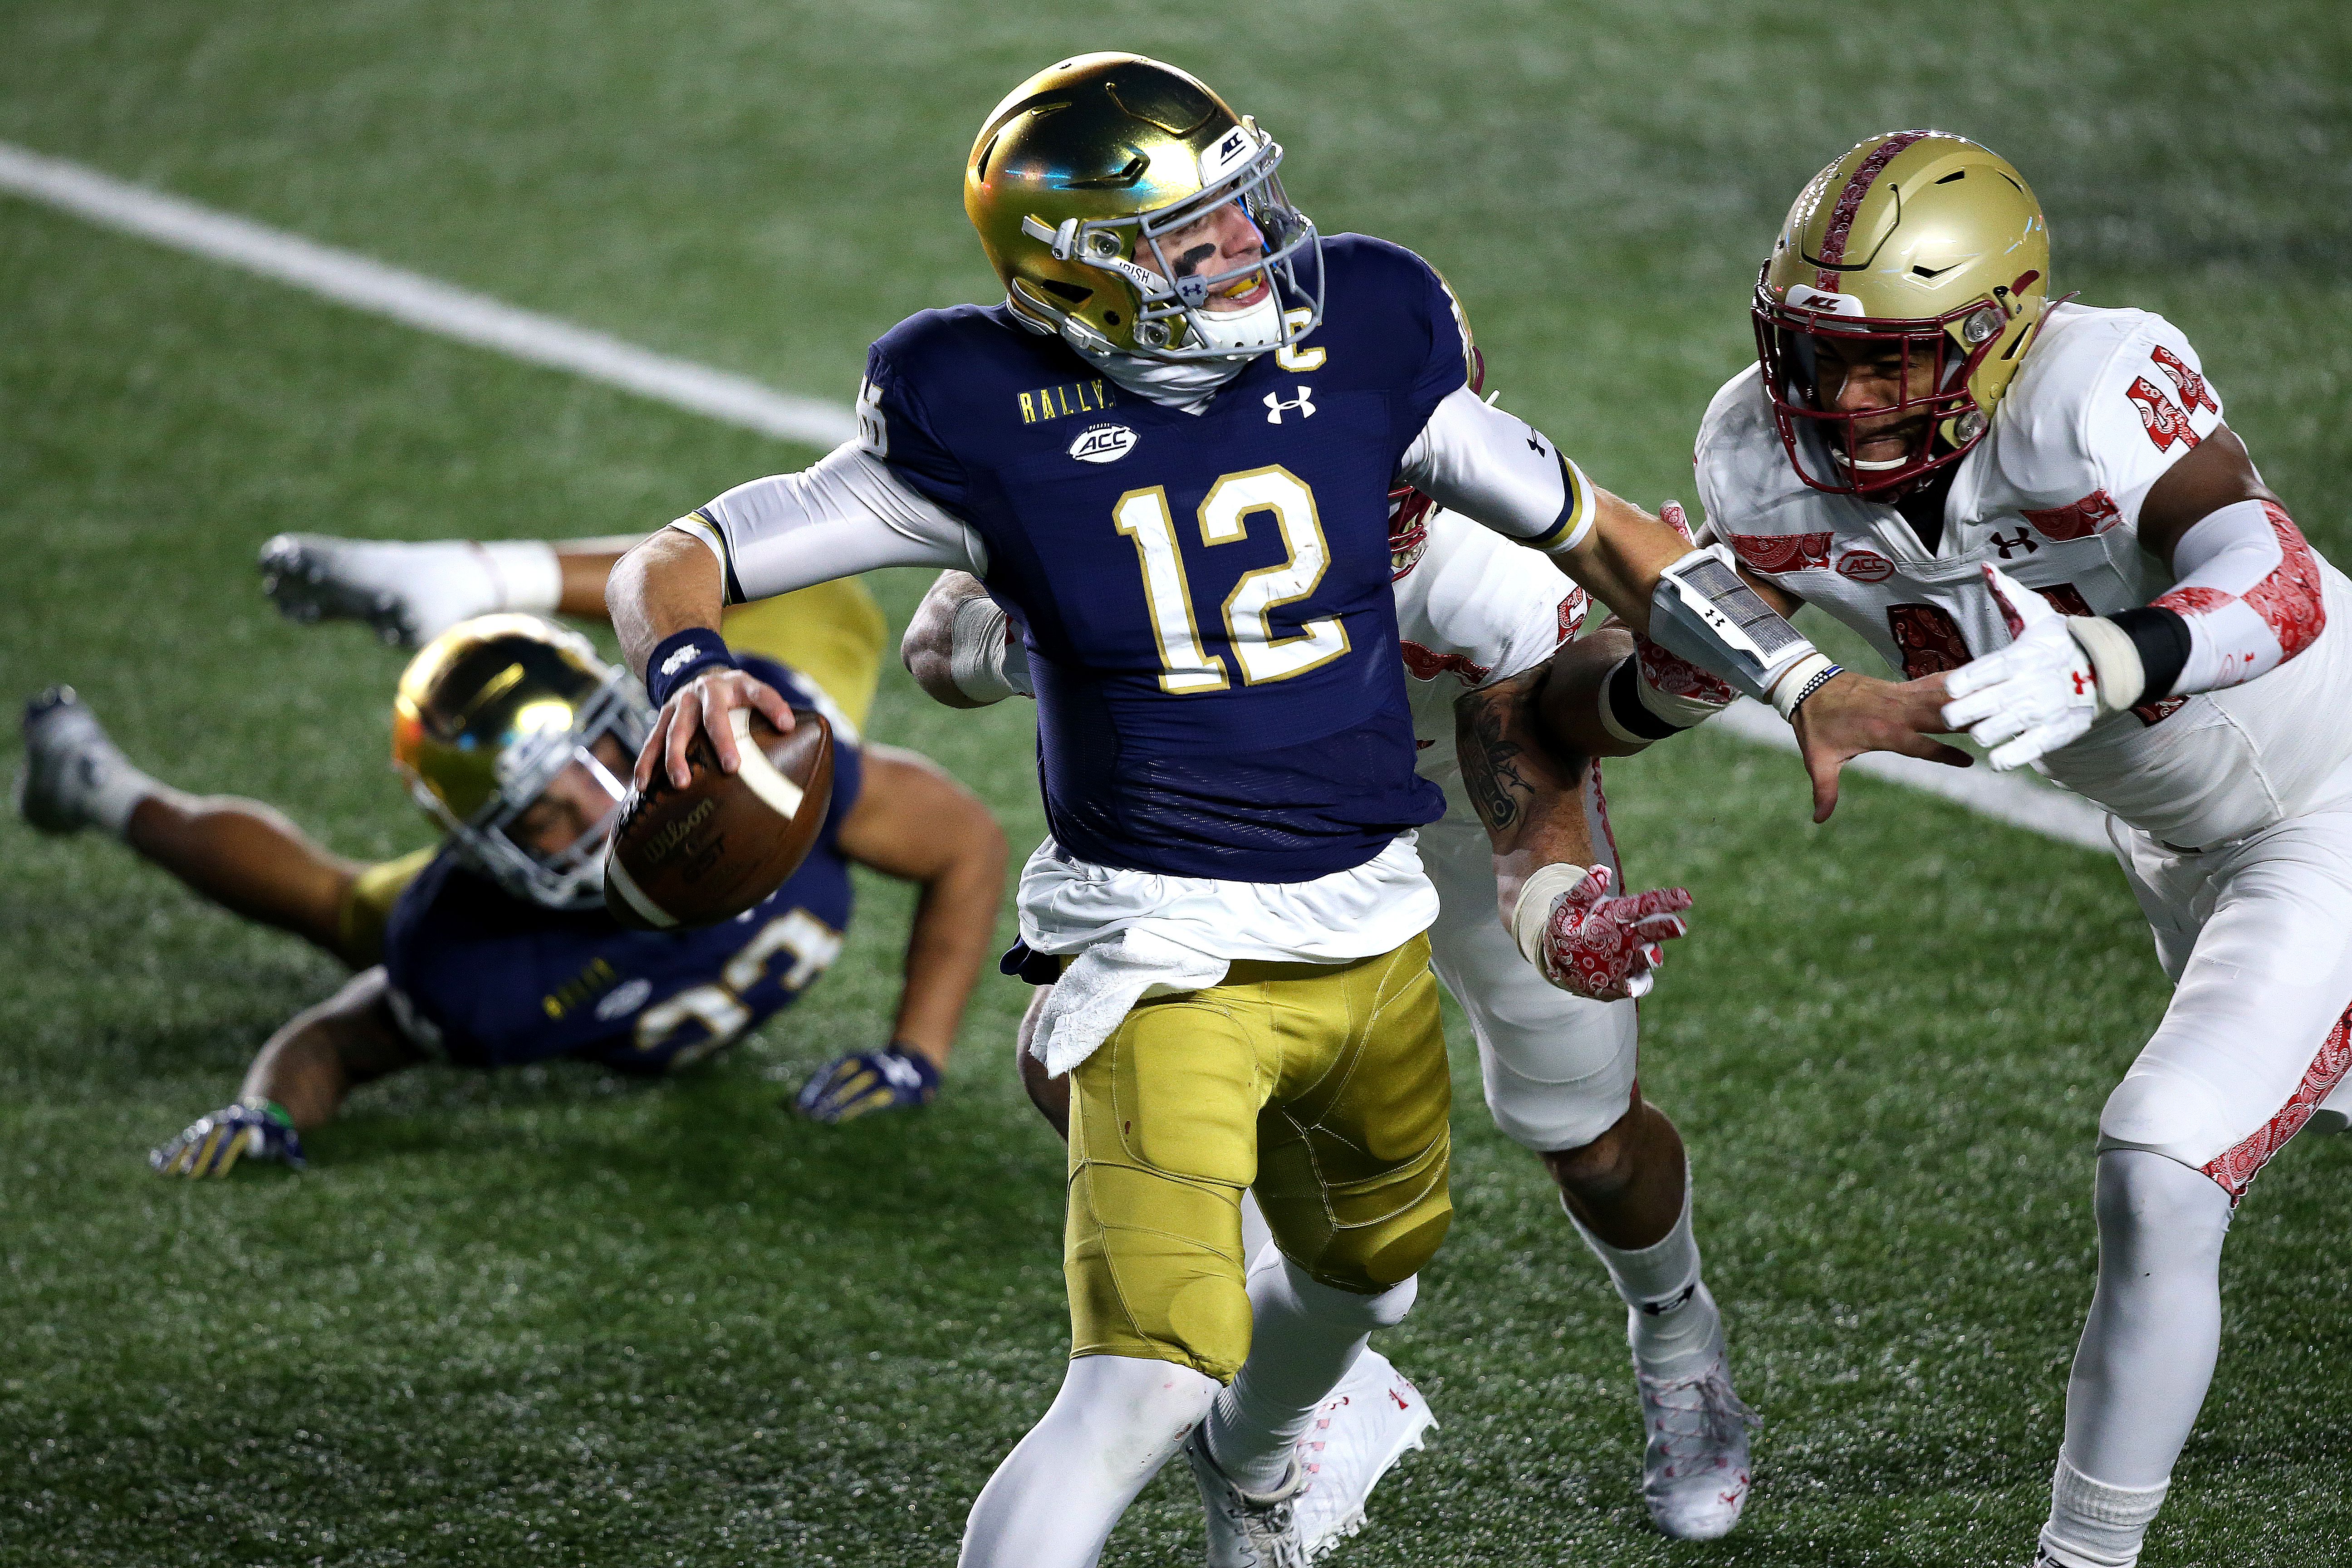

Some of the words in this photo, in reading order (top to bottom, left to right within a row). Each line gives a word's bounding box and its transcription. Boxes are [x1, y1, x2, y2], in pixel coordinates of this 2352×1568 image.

[1802, 295, 1841, 311] ACC
[1275, 307, 1327, 372] C
[2126, 344, 2218, 454] 44
[1078, 429, 1127, 454] ACC
[1112, 464, 1352, 695] 12
[1846, 558, 1886, 572] ACC
[643, 798, 715, 863] Wilson
